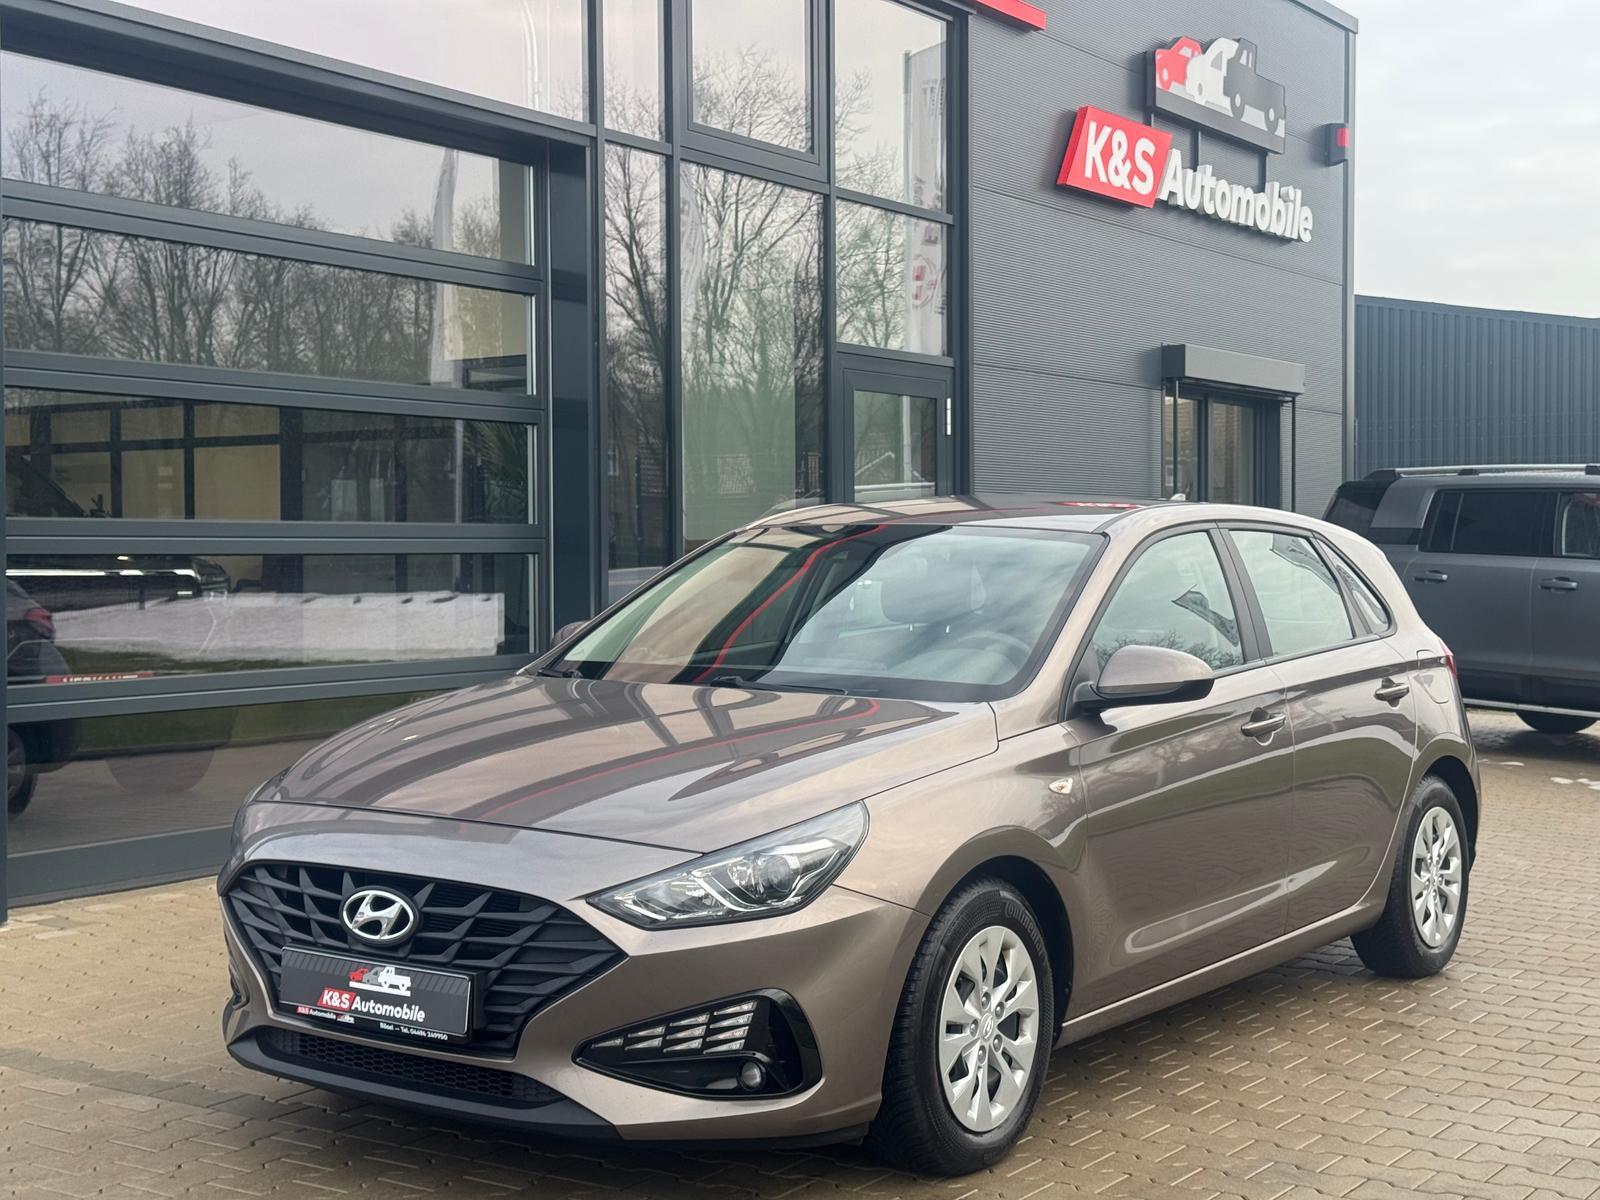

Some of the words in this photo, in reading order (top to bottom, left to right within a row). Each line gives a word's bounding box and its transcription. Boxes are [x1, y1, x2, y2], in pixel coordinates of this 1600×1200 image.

[1084, 121, 1155, 195] K&S
[1158, 148, 1313, 242] Automobile
[322, 989, 350, 1009] K&S
[351, 995, 425, 1022] Automobile
